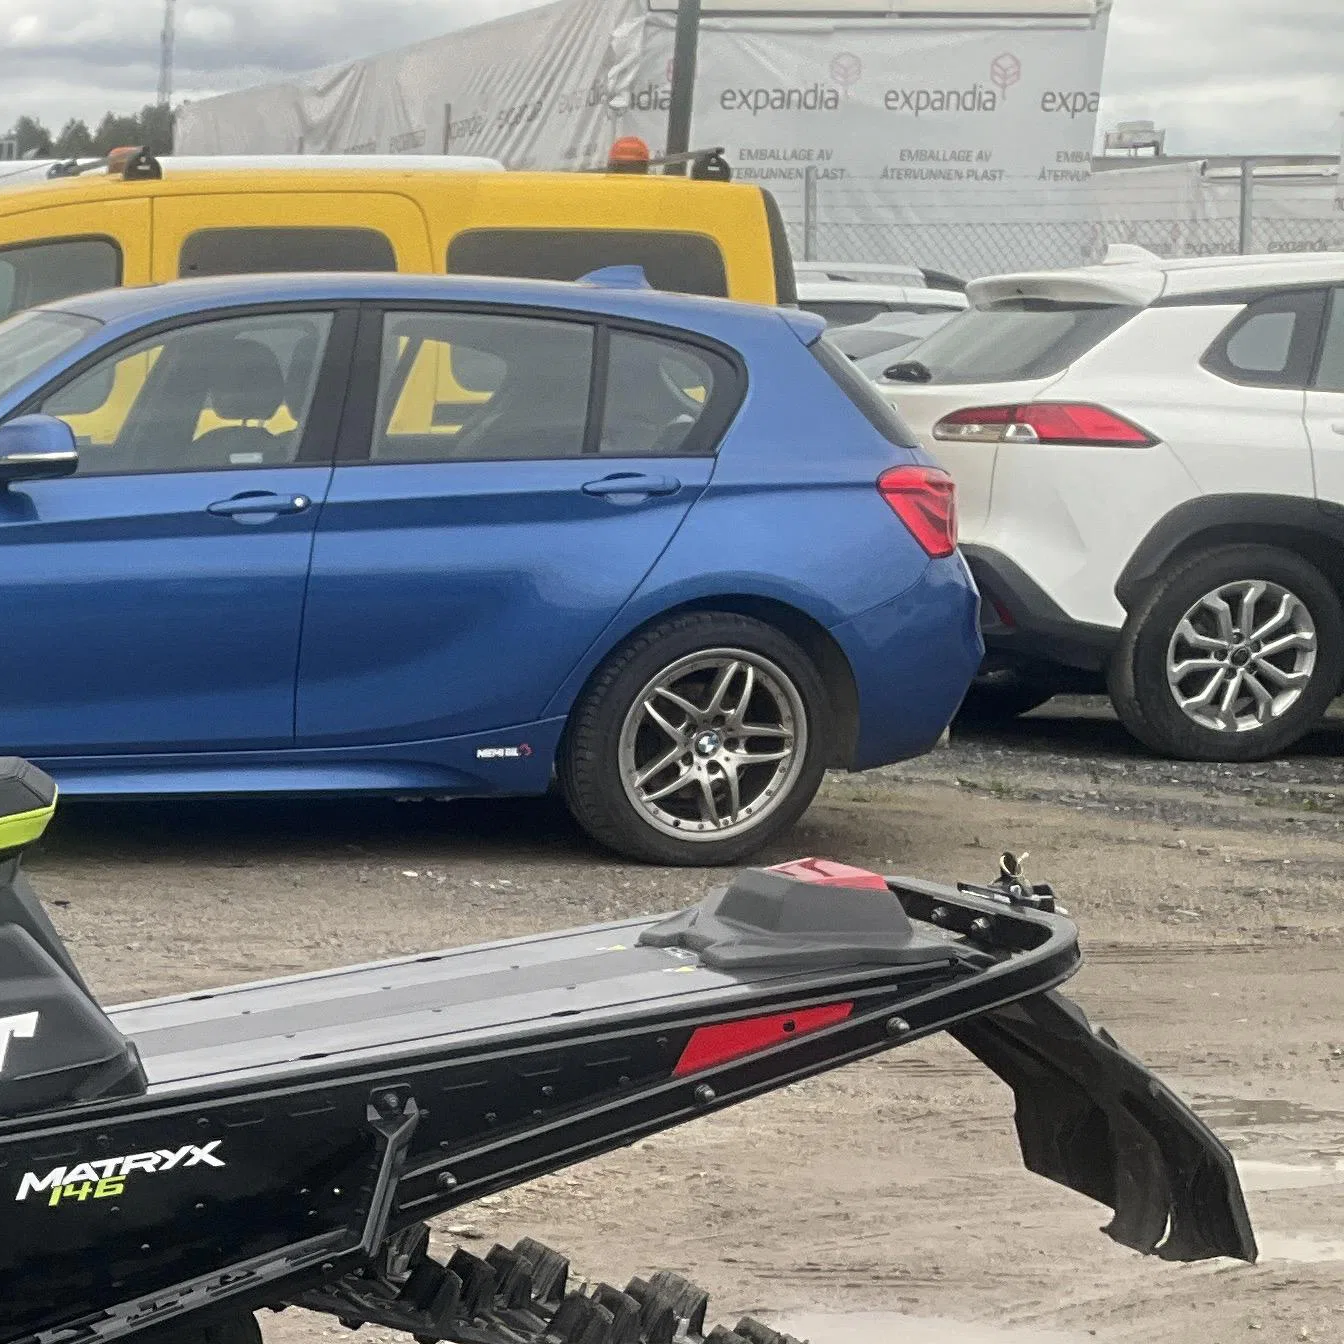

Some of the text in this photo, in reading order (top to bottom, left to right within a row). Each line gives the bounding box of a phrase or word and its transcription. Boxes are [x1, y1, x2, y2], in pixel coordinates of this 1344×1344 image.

[720, 83, 839, 116] expandia
[885, 83, 996, 117] expandia
[1041, 91, 1100, 118] expa
[739, 148, 834, 161] EMBALLAGE AV
[899, 149, 992, 162] EMBALLAGE AV
[731, 167, 846, 181] TERVUNNEN LAST
[880, 165, 1005, 182] ÅTERVUNNEN PLAST
[15, 1139, 227, 1201] MATRYX
[48, 1174, 127, 1207] 146
